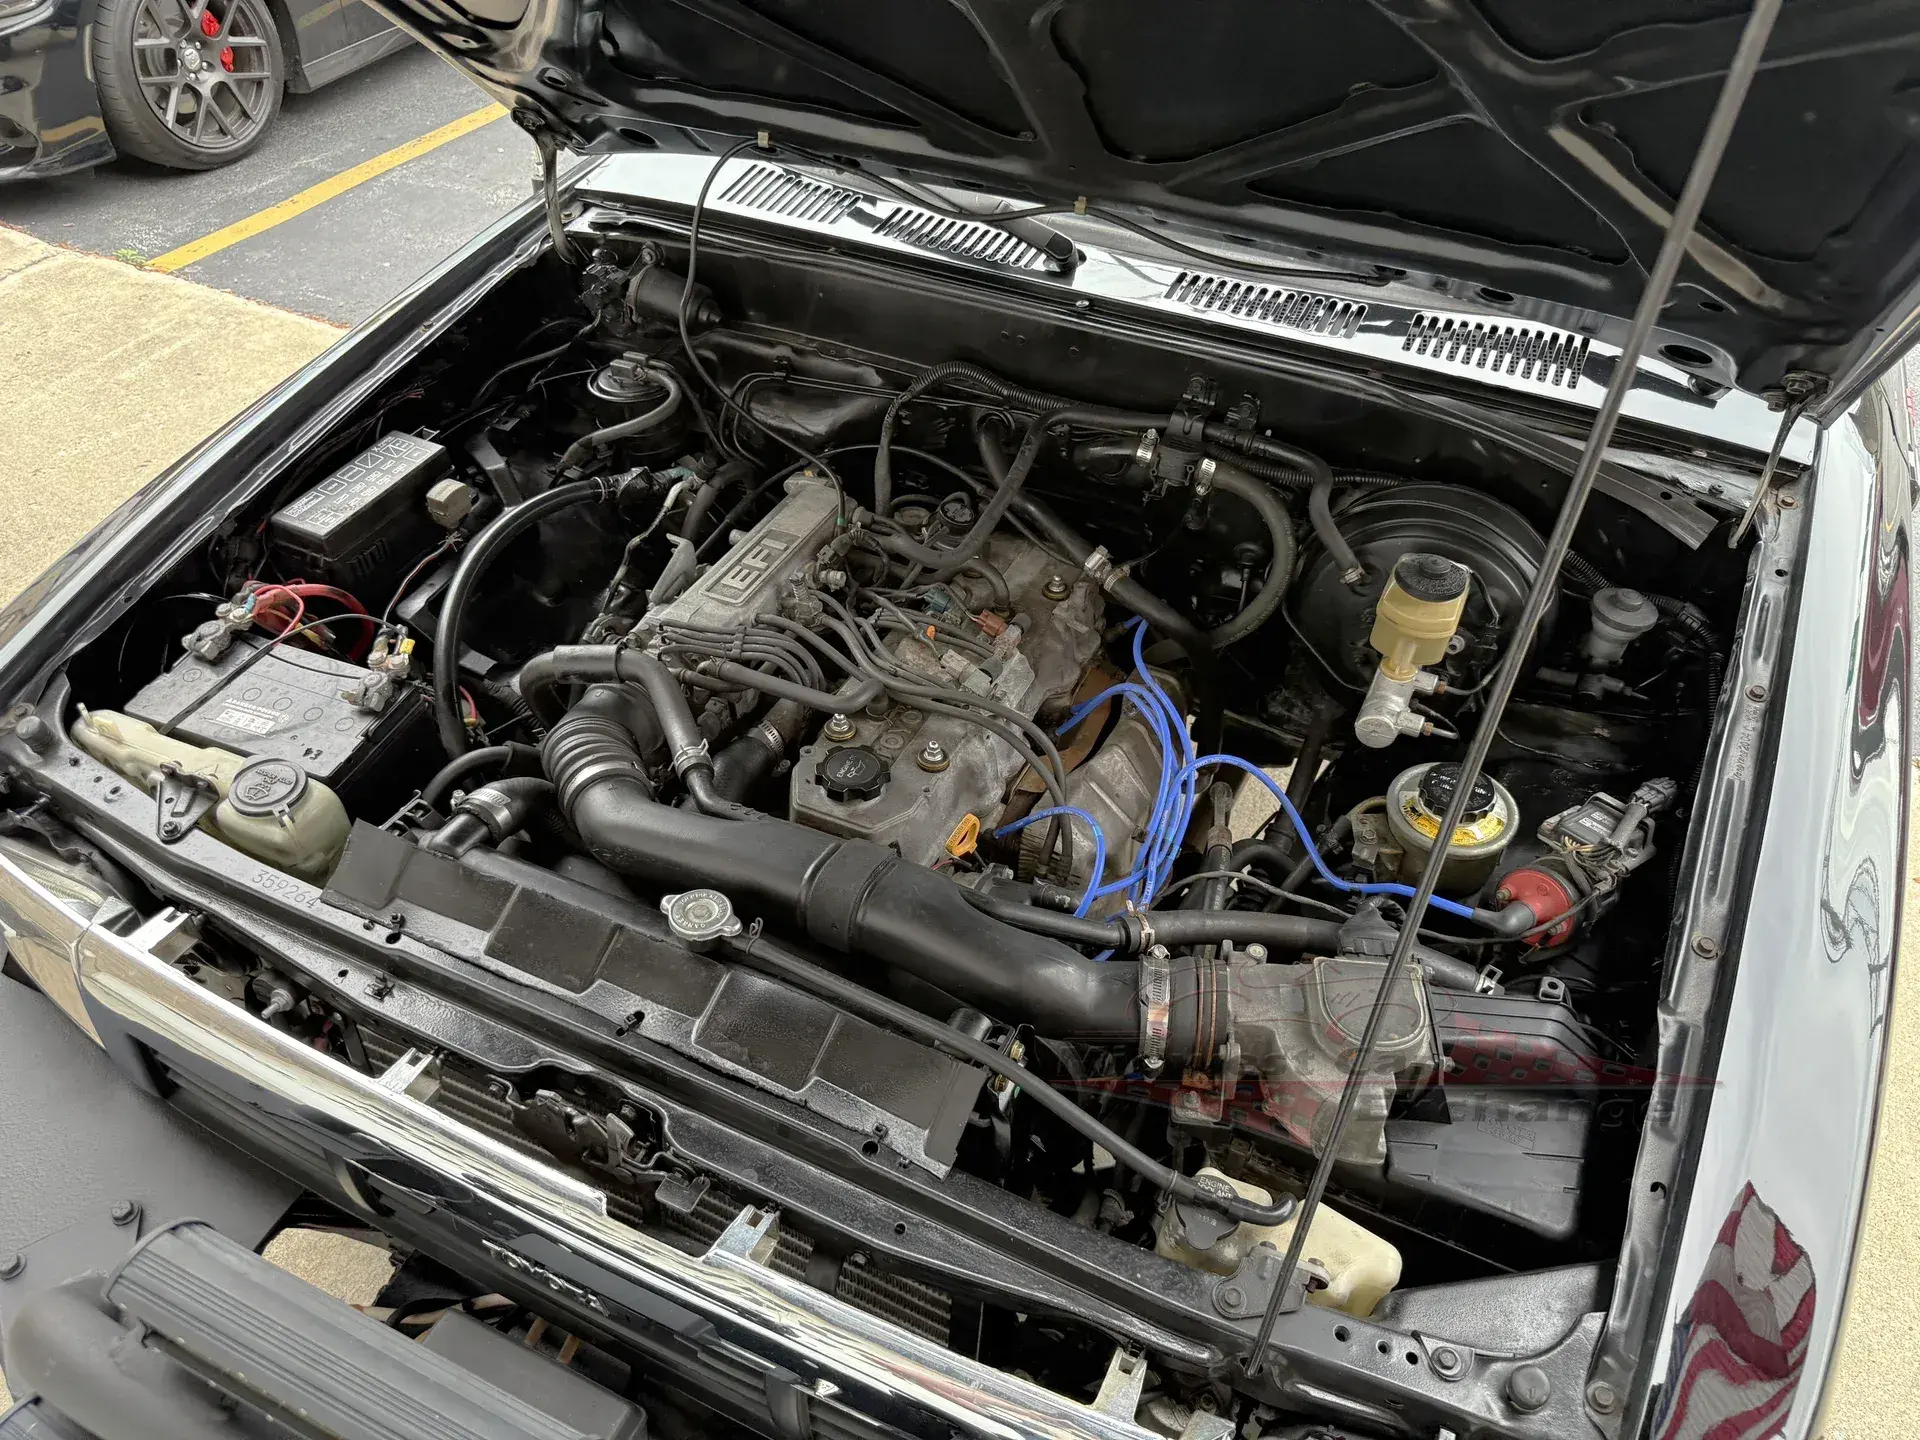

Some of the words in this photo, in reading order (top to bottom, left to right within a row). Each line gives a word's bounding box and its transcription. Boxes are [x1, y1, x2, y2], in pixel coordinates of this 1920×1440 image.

[720, 538, 788, 591] EFI
[252, 869, 321, 909] 359264
[1199, 1176, 1231, 1192] ENGINE
[482, 1239, 611, 1317] TOYOTA
